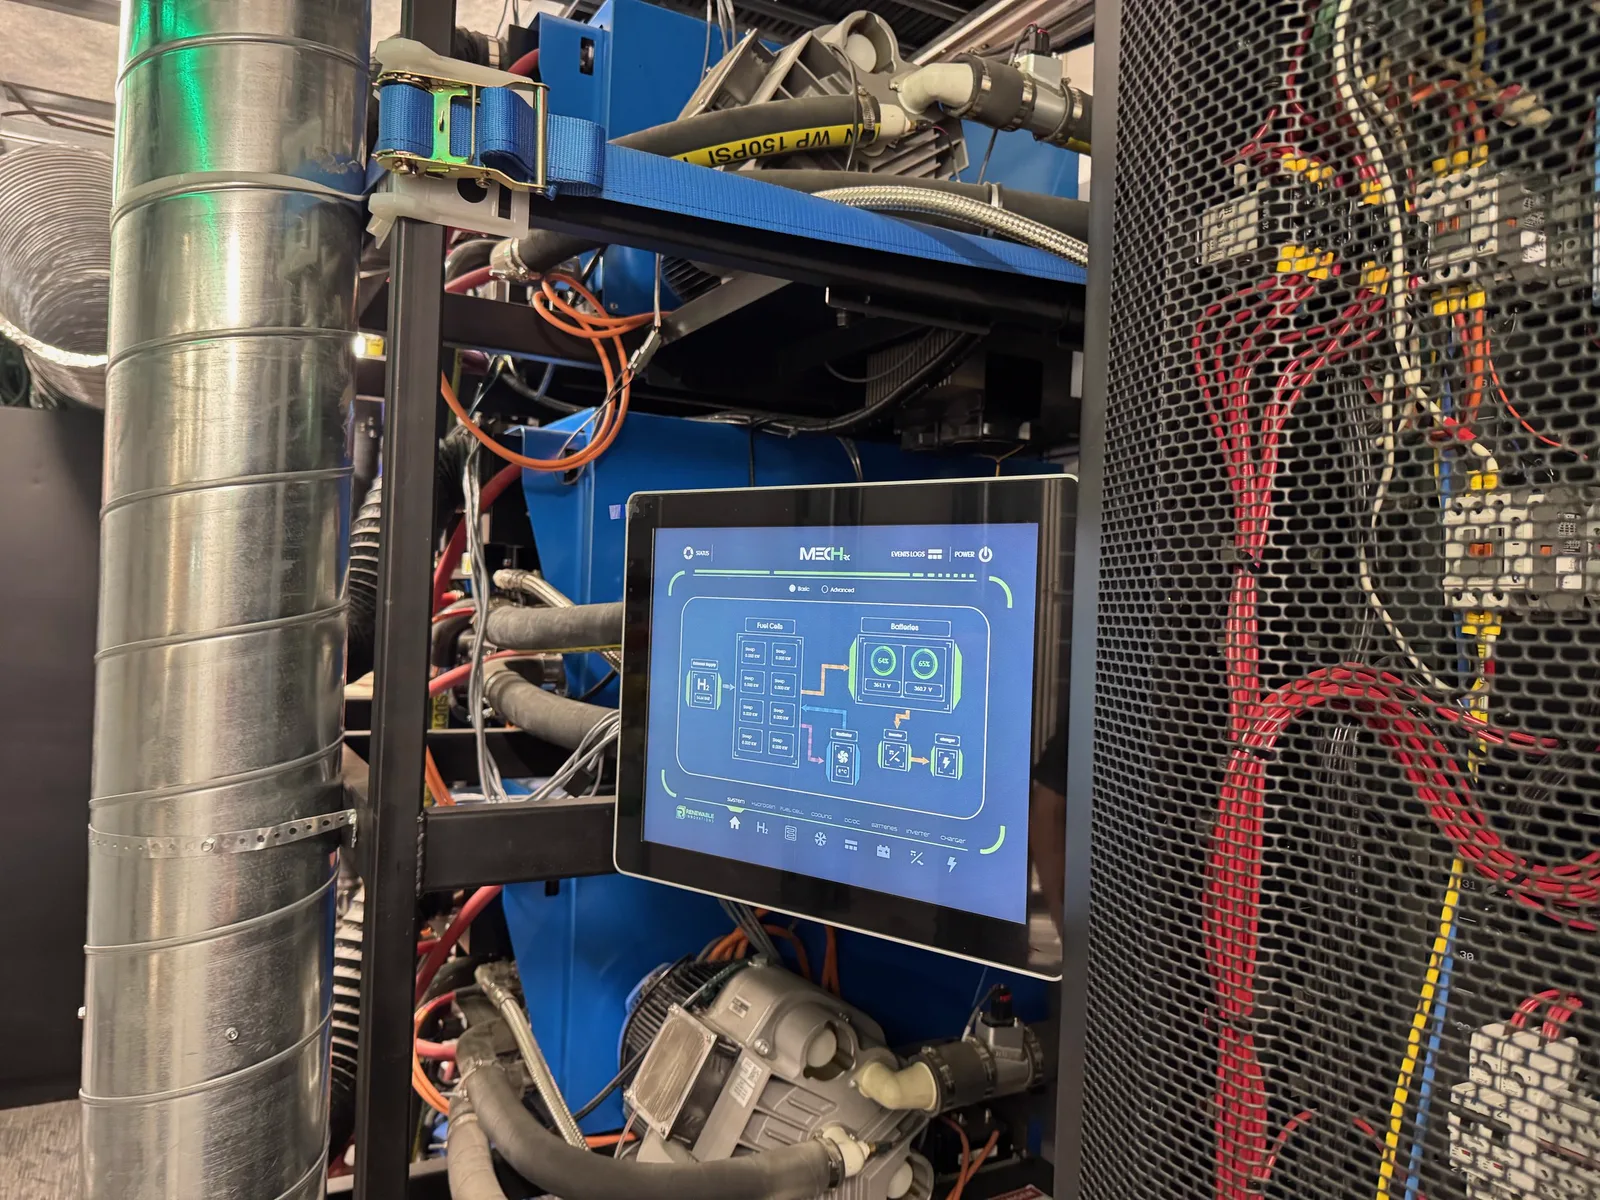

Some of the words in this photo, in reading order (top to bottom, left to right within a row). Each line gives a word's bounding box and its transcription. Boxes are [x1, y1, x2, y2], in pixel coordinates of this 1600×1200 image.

[796, 130, 830, 148] WP
[709, 136, 788, 165] 150PSI
[891, 550, 910, 558] EVENTS
[910, 550, 926, 558] LOGS
[770, 622, 784, 630] Cells
[890, 622, 919, 632] Batteries
[686, 809, 714, 819] RENEWABLE
[1462, 879, 1476, 890] 31
[1459, 950, 1474, 961] 30
